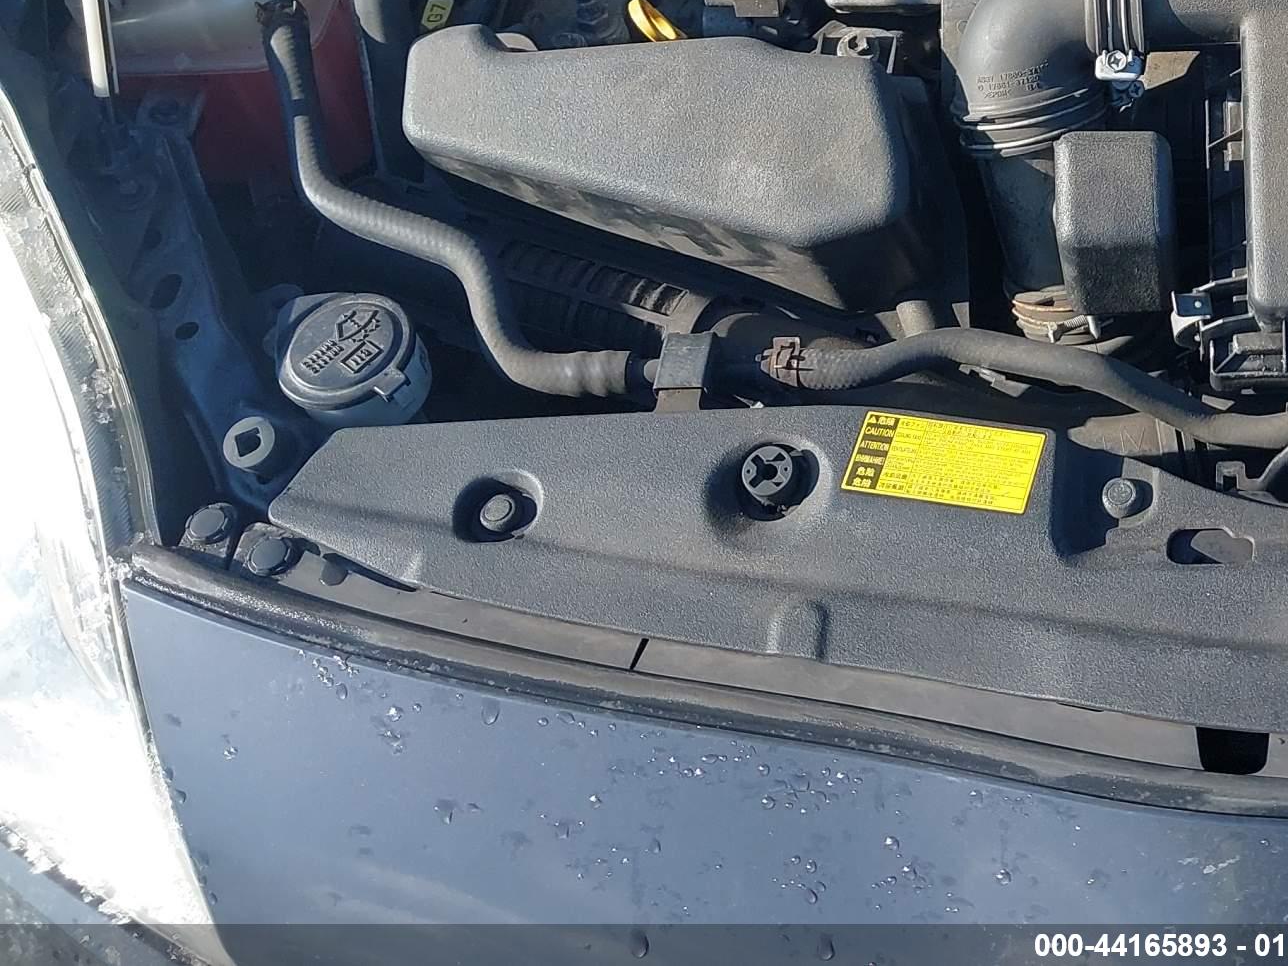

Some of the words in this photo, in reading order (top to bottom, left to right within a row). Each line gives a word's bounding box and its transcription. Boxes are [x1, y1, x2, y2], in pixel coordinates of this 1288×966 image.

[426, 3, 447, 23] G7
[864, 427, 895, 438] CAUTION
[859, 440, 890, 452] ATTENTION
